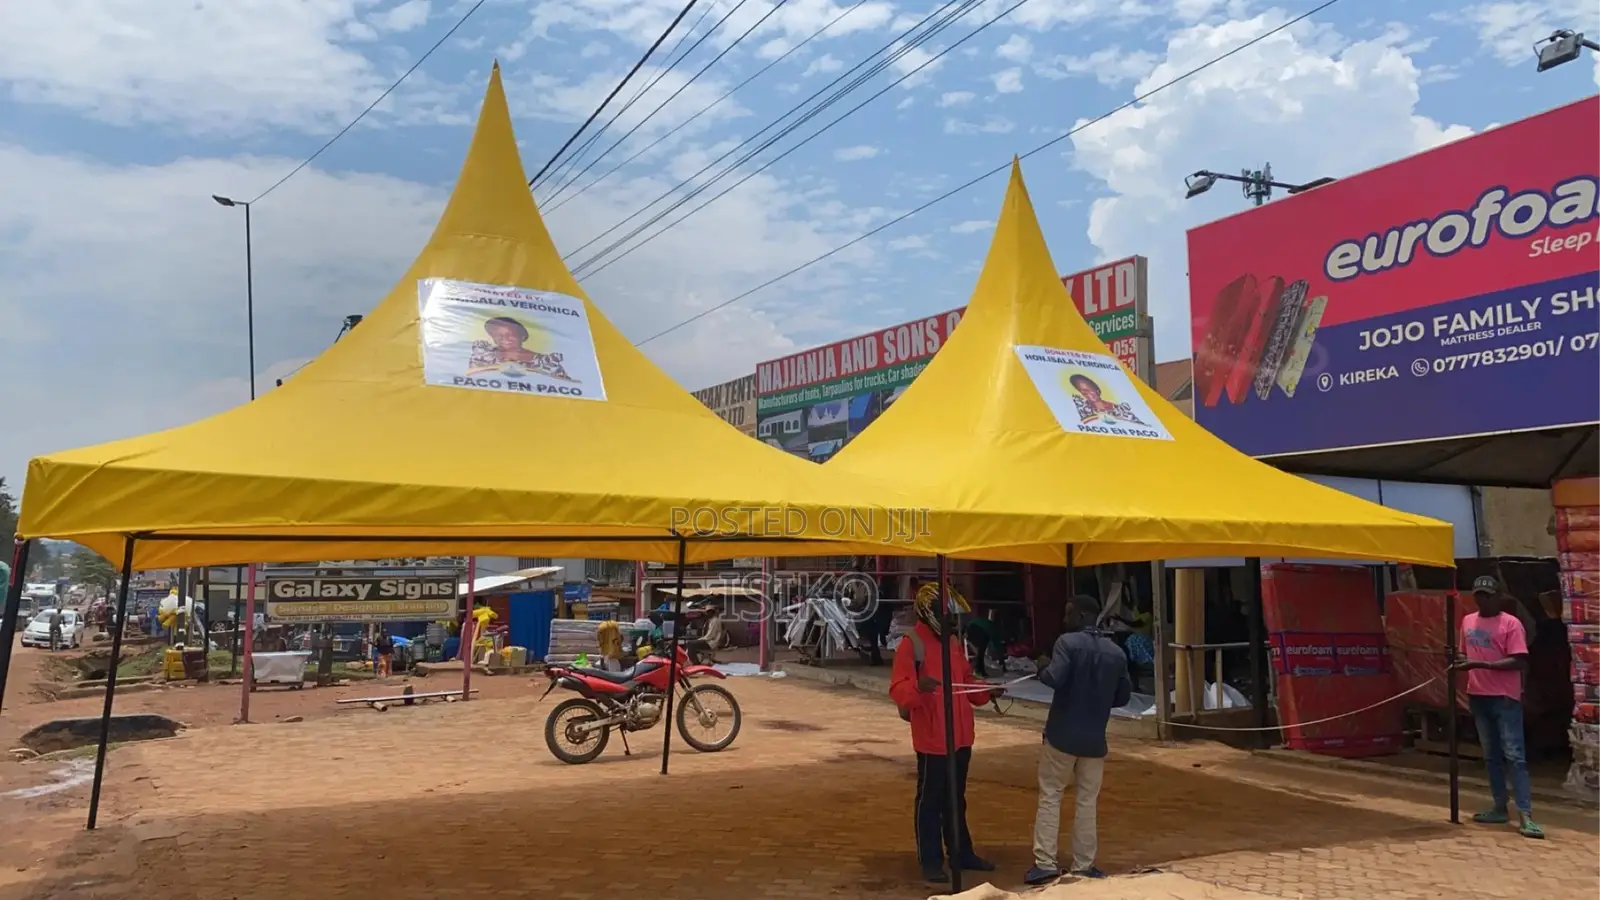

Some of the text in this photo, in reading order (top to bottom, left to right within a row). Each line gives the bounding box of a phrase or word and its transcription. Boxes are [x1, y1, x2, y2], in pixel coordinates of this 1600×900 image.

[1325, 177, 1600, 281] eurofoa
[1528, 231, 1592, 257] Sleep
[1083, 262, 1135, 315] LTD
[509, 299, 580, 318] VERONICA
[1358, 286, 1600, 352] JOJO FAMILY SH
[1440, 321, 1542, 347] MATTRESS DEALER
[758, 347, 837, 394] MAJJANJA
[841, 335, 878, 375] AND
[883, 318, 940, 365] SONS
[1044, 348, 1081, 359] DONATED
[1113, 337, 1136, 357] 053
[1432, 335, 1565, 373] 0777832901/
[1075, 359, 1121, 371] VERONICA
[1339, 365, 1399, 387] KIREKA
[453, 375, 583, 397] PACO EN PACO
[822, 381, 854, 398] Tarpaulins
[854, 376, 864, 391] for
[888, 368, 900, 383] Car
[693, 384, 722, 410] CAN
[1077, 424, 1159, 438] PACO EN PACO
[273, 579, 454, 600] Galaxy Signs
[333, 602, 391, 613] Designing
[1287, 645, 1333, 656] eurofoam
[1336, 645, 1379, 656] eurofoam
